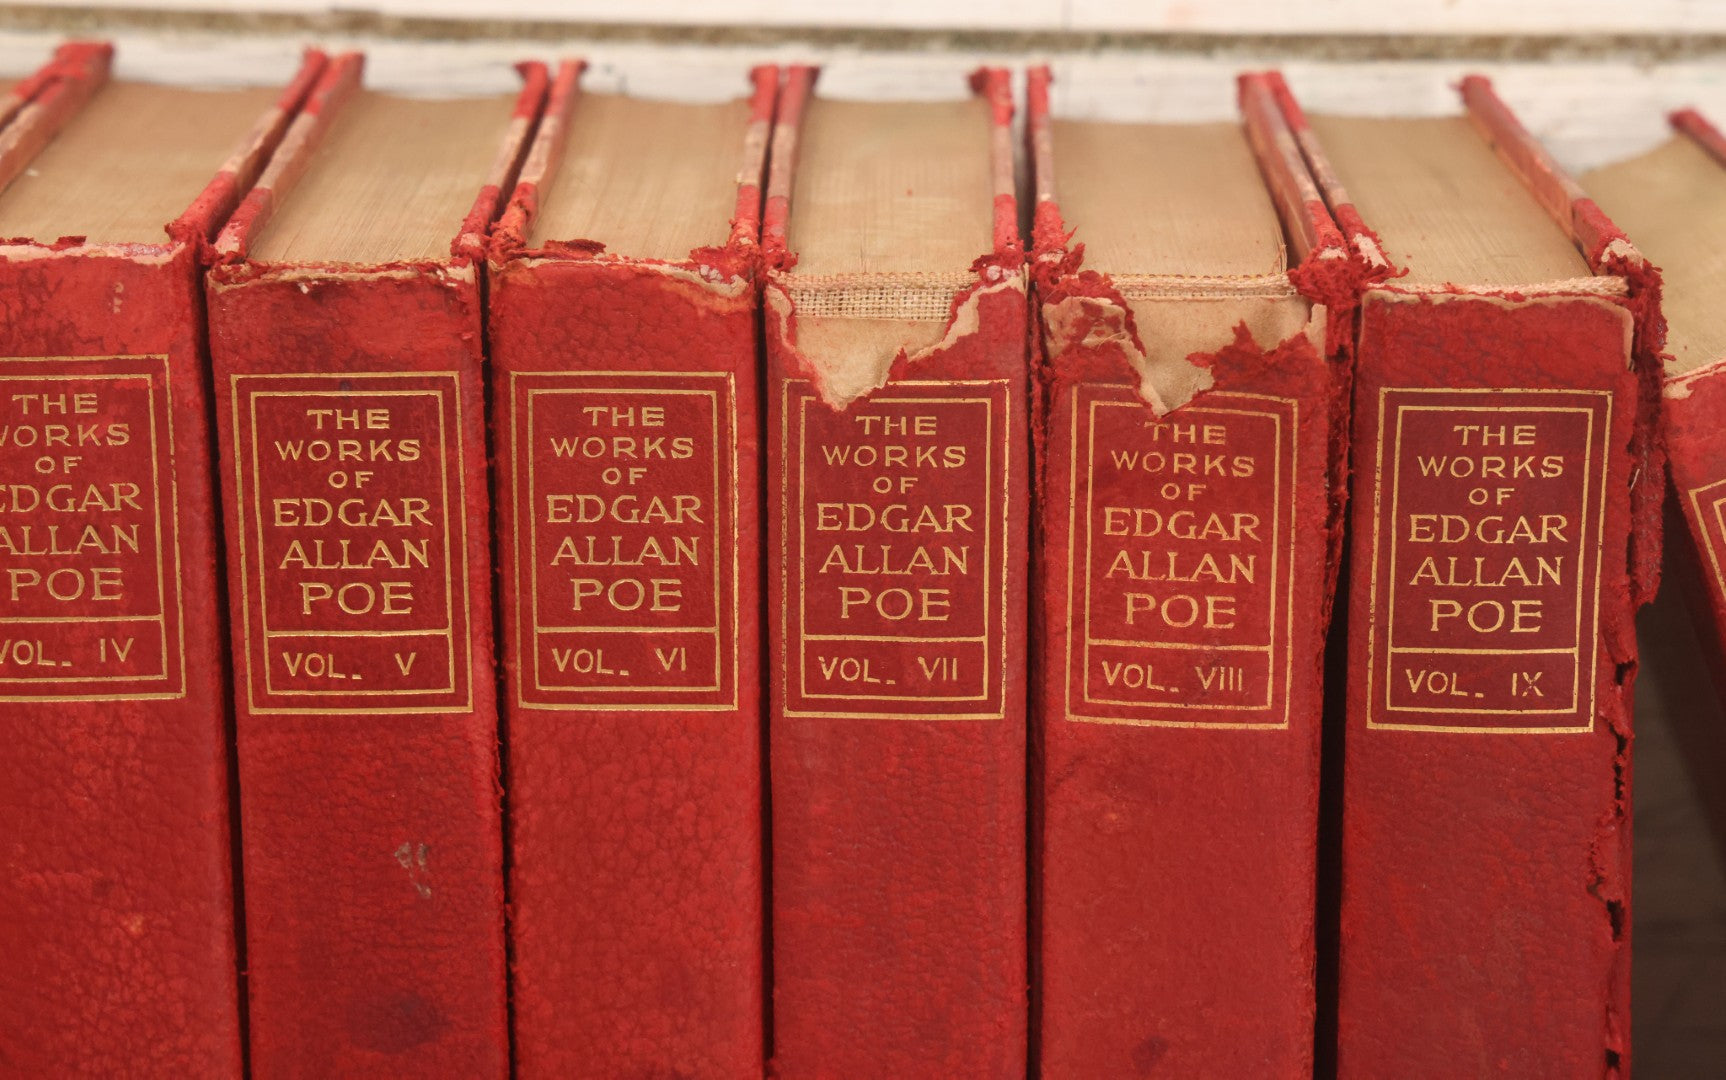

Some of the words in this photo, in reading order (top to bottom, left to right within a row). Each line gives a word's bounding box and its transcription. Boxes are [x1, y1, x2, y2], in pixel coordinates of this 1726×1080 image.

[11, 392, 98, 415] THE
[582, 406, 665, 427] THE
[306, 408, 391, 430] THE
[854, 415, 937, 436] THE
[1143, 421, 1226, 445] THE
[274, 438, 421, 462] WORKS
[549, 436, 694, 460] WORKS
[1452, 424, 1537, 447] THE
[34, 455, 83, 474] OF
[821, 444, 966, 469] WORKS
[1110, 449, 1255, 478] WORKS
[1416, 455, 1564, 479] WORKS
[327, 470, 374, 489] OF
[601, 467, 648, 486] OF
[872, 476, 919, 495] OF
[0, 482, 143, 513] DGAR
[1160, 482, 1207, 502] OF
[1468, 487, 1516, 506] OF
[272, 497, 434, 528] EDGAR
[546, 493, 705, 525] EDGAR
[815, 502, 974, 534] EDGAR
[1103, 506, 1262, 542] EDGAR
[1408, 513, 1569, 545] EDGAR
[278, 538, 430, 570] ALLAN
[549, 535, 700, 566] ALLAN
[818, 544, 970, 576] ALLAN
[1105, 549, 1257, 584] ALLAN
[1408, 555, 1564, 587] ALLAN
[5, 567, 124, 602] POE
[298, 581, 414, 616] POE
[569, 578, 683, 612] POE
[837, 586, 951, 622] POE
[1122, 591, 1237, 630] POE
[1428, 598, 1544, 633] POE
[99, 637, 135, 663] IV
[551, 647, 630, 677] VOL.
[653, 646, 687, 672] VI
[282, 651, 363, 680] VOL.
[394, 651, 417, 677] V
[817, 655, 897, 685] VOL.
[917, 656, 958, 682] VII
[1101, 660, 1180, 693] VOL.
[1194, 666, 1243, 692] VIII
[1405, 668, 1485, 699] VOL.
[1511, 671, 1544, 697] IX
